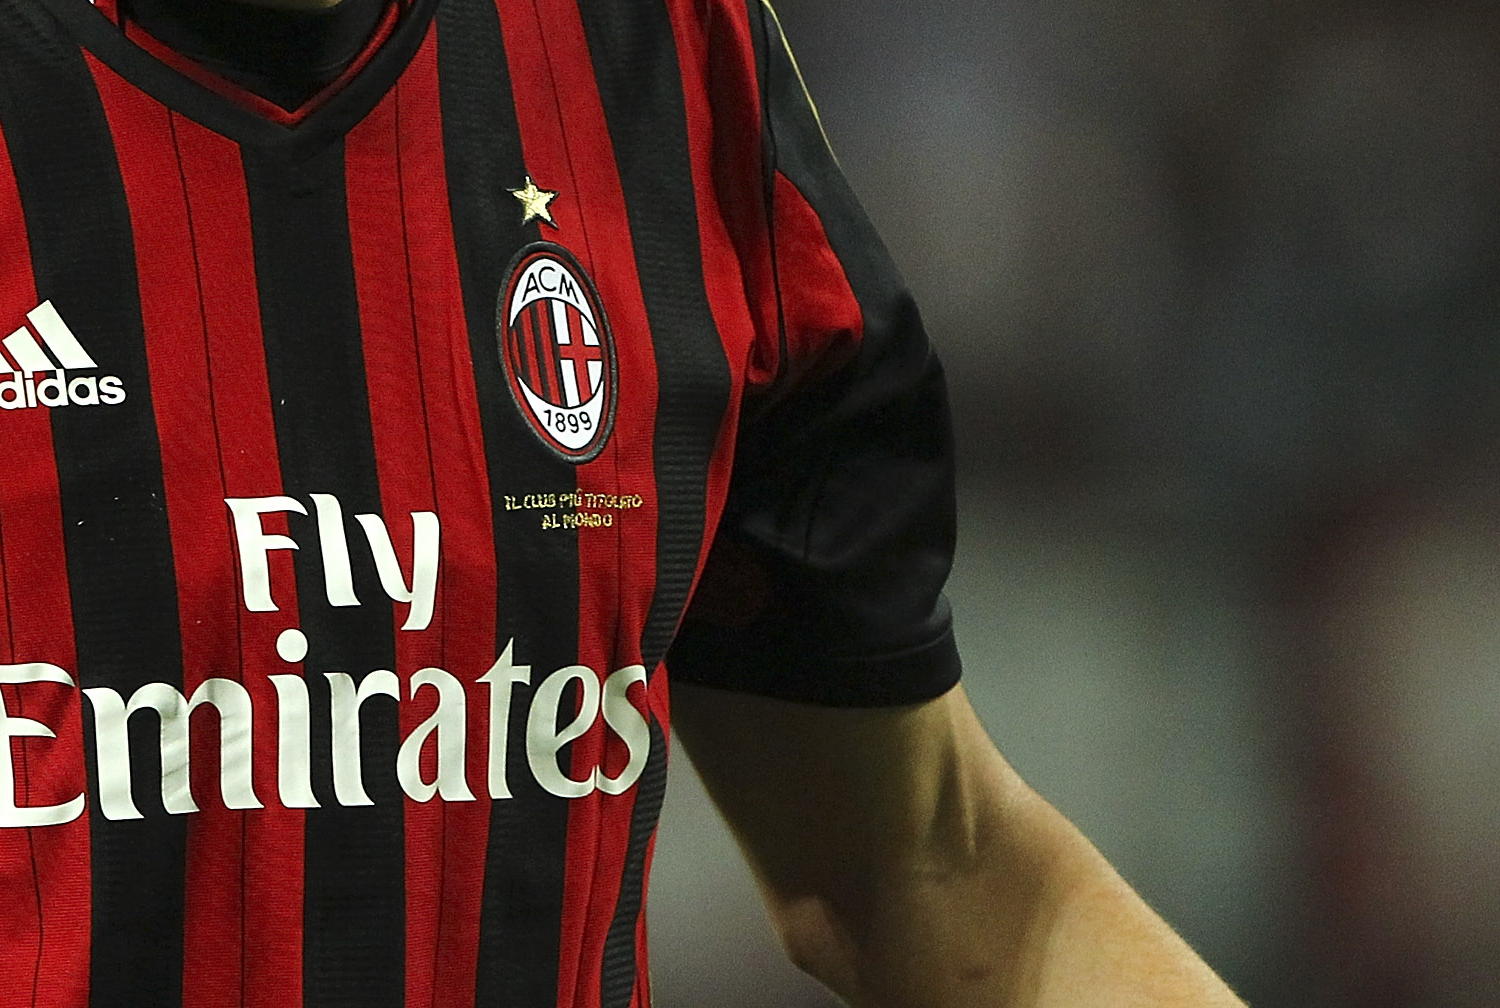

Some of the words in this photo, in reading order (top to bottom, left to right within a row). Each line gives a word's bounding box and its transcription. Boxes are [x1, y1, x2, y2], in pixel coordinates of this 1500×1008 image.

[521, 266, 580, 305] ACM
[543, 409, 592, 434] 1899
[523, 494, 557, 509] CLUB
[541, 513, 560, 529] AL
[224, 493, 440, 630] Fly
